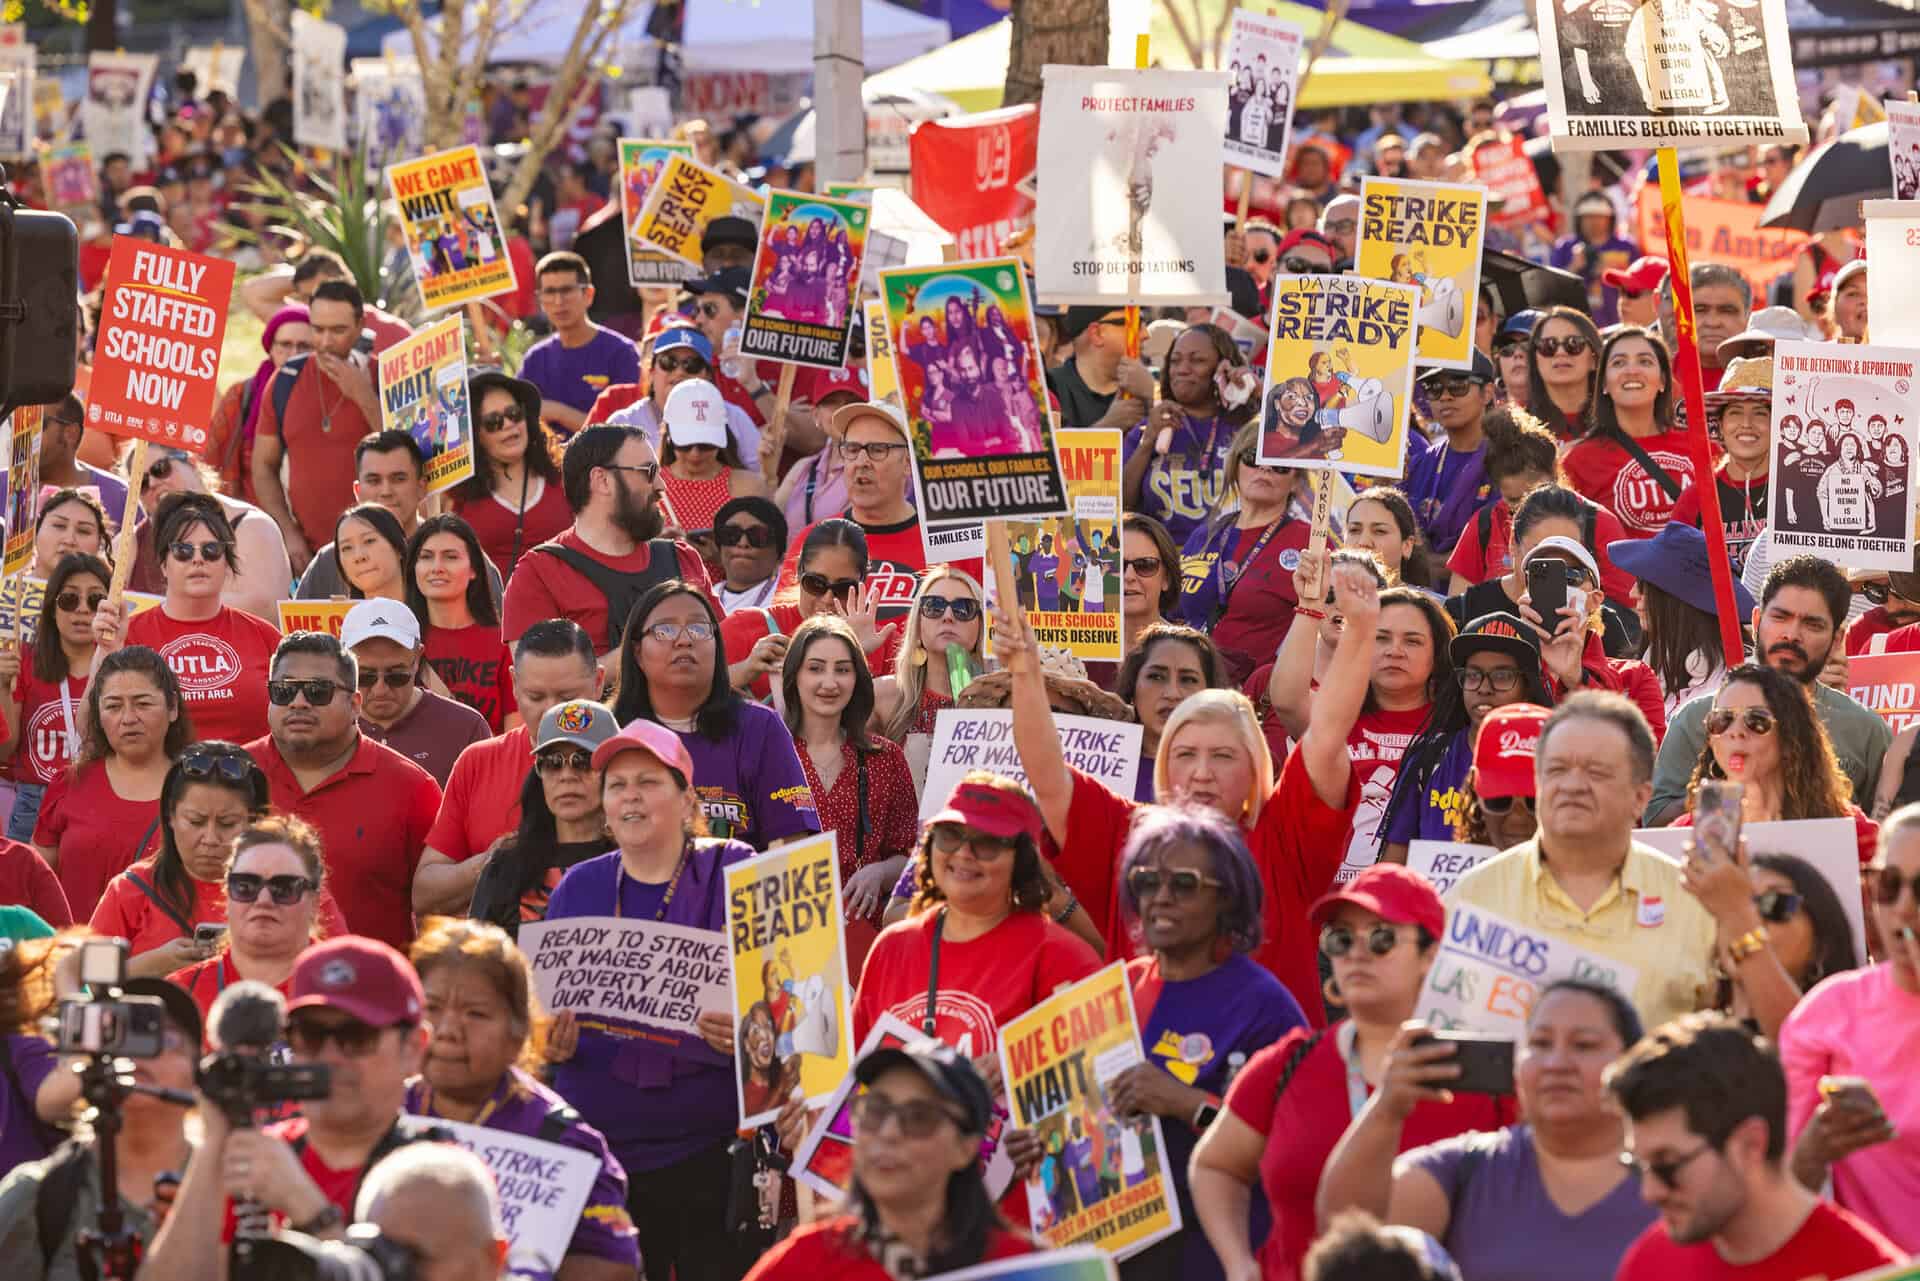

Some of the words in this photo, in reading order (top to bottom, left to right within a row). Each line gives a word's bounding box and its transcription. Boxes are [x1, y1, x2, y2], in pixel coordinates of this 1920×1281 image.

[1654, 43, 1691, 54] HUMAN
[1661, 59, 1691, 69] BEING
[1674, 75, 1685, 84] IS
[1081, 96, 1138, 112] PROTECT
[1140, 97, 1195, 112] FAMILIES
[1568, 120, 1637, 137] FAMILIES
[1641, 121, 1701, 137] BELONG
[1705, 121, 1784, 137] TOGETHER
[395, 173, 424, 197] WE
[427, 157, 478, 189] CAN'T
[402, 188, 454, 222] WAIT
[648, 162, 697, 246] STRIKE
[665, 168, 714, 253] READY
[1365, 194, 1478, 225] STRIKE
[1363, 218, 1476, 249] READY
[133, 250, 207, 294] FULLY
[1073, 261, 1104, 275] STOP
[1106, 260, 1195, 275] DEPORTATIONS
[1299, 275, 1375, 296] DARBY
[113, 287, 216, 337] STAFFED
[1279, 292, 1410, 326] STRIKE
[746, 329, 779, 351] OUR
[780, 334, 840, 361] FUTURE.
[1277, 316, 1408, 350] READY
[105, 327, 216, 380] SCHOOLS
[384, 353, 409, 385] WE
[412, 328, 459, 371] CAN'T
[1780, 356, 1795, 370] END
[1796, 357, 1808, 371] THE
[1809, 359, 1851, 374] DETENTIONS
[1853, 361, 1859, 374] &
[1862, 361, 1913, 377] DEPORTATIONS
[126, 369, 187, 410] NOW
[385, 366, 433, 413] WAIT
[104, 411, 123, 424] UTLA
[441, 455, 470, 478] DESERVE
[1060, 448, 1117, 480] AN'T
[927, 481, 971, 510] OUR
[972, 475, 1059, 508] FUTURE.
[1841, 477, 1851, 485] NO
[1837, 497, 1857, 505] BEING
[1833, 517, 1862, 525] ILLEGAL!
[928, 529, 970, 546] FAMILIES
[1774, 533, 1816, 546] FAMILIES
[1818, 536, 1855, 550] BELONG
[1856, 539, 1906, 553] TOGETHER
[1031, 614, 1040, 625] IN
[1043, 614, 1062, 627] THE
[1065, 615, 1115, 628] SCHOOLS
[1070, 629, 1118, 644] DESERVE
[168, 655, 232, 674] UTLA
[208, 689, 234, 700] AREA
[1850, 684, 1915, 711] FUND
[952, 720, 1013, 741] READY
[942, 745, 980, 765] FOR
[701, 803, 741, 822] FOR
[731, 859, 831, 921] STRIKE
[734, 893, 832, 956] READY
[540, 928, 610, 950] READY
[617, 930, 644, 949] TO
[650, 935, 729, 964] STRIKE
[1451, 909, 1549, 975] UNIDOS
[533, 950, 573, 971] FOR
[577, 949, 653, 970] WAGES
[658, 957, 731, 986] ABOVE
[552, 989, 595, 1009] OUR
[555, 969, 656, 991] POVERTY
[658, 978, 701, 1004] FOR
[1008, 1026, 1048, 1080] WE
[1050, 984, 1129, 1058] CAN'T
[1014, 1047, 1090, 1125] WAIT
[483, 1146, 568, 1181] STRIKE
[497, 1175, 565, 1208] BOVE
[1108, 1175, 1162, 1217] SCHOOLS
[1117, 1196, 1168, 1232] DESERVE
